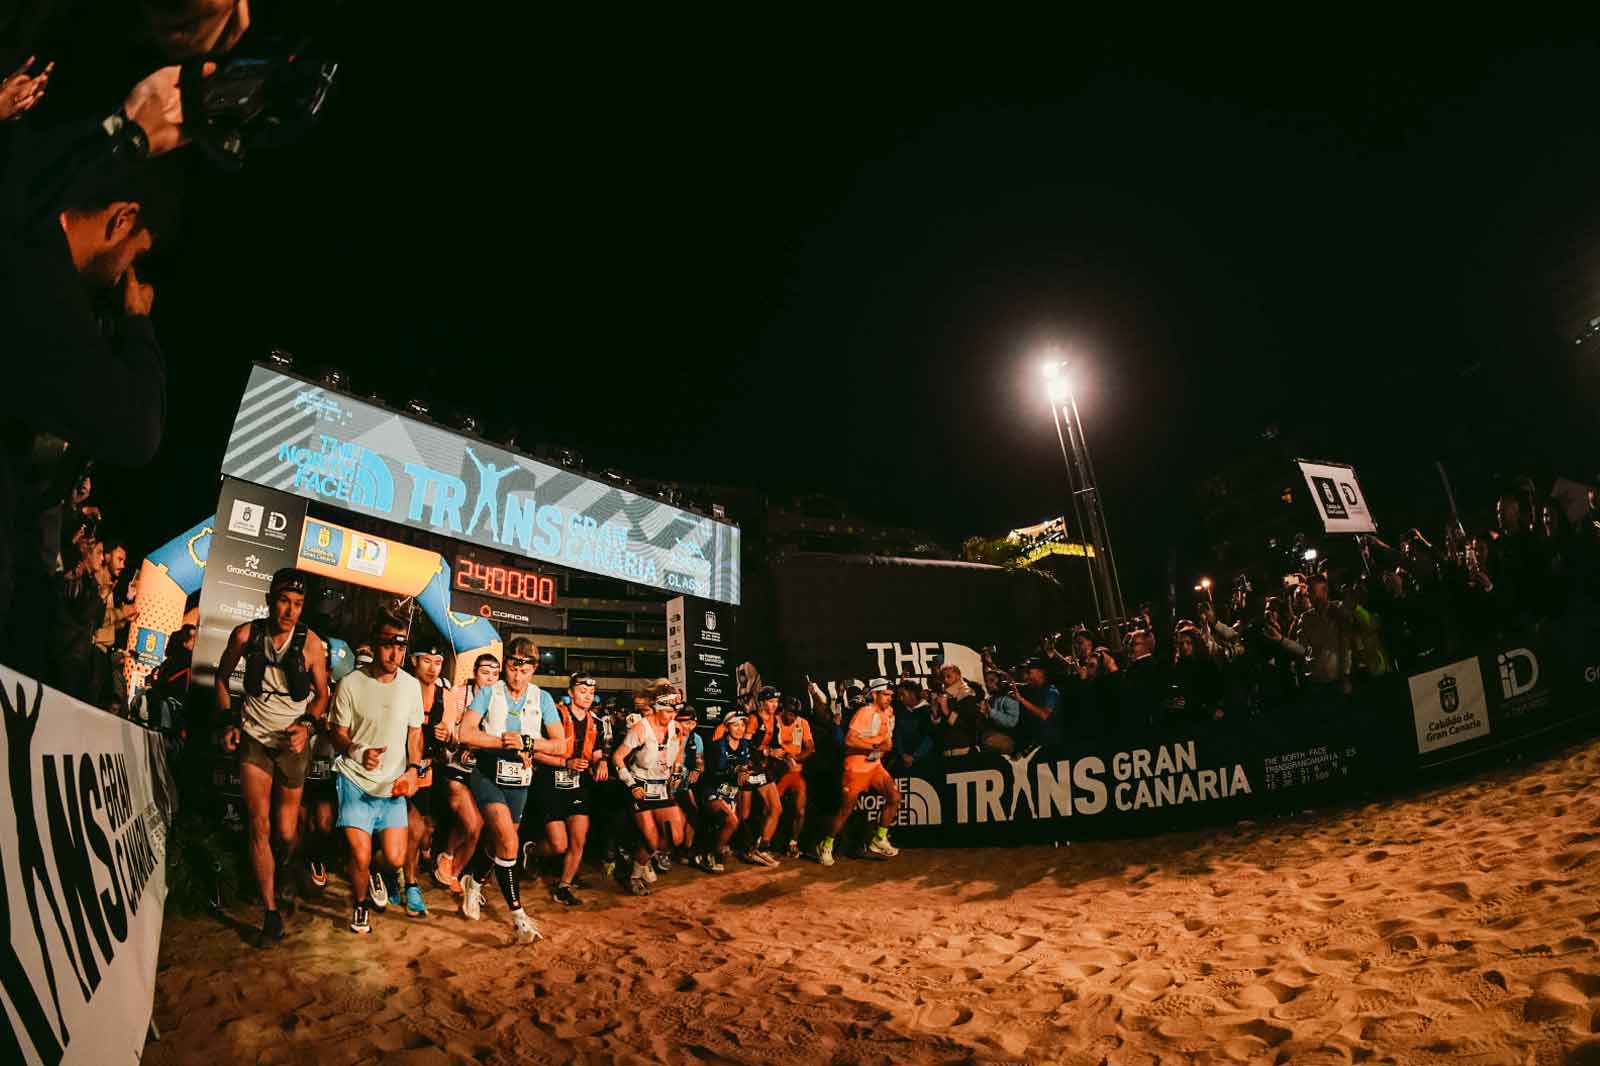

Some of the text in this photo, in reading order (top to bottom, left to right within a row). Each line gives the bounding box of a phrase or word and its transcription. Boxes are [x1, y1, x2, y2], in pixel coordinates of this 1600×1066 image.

[294, 466, 349, 501] FACE
[492, 609, 529, 622] COROS
[866, 642, 939, 677] THE
[1463, 711, 1474, 721] de
[1112, 741, 1197, 781] GRAN
[1115, 764, 1252, 811] CANARIA
